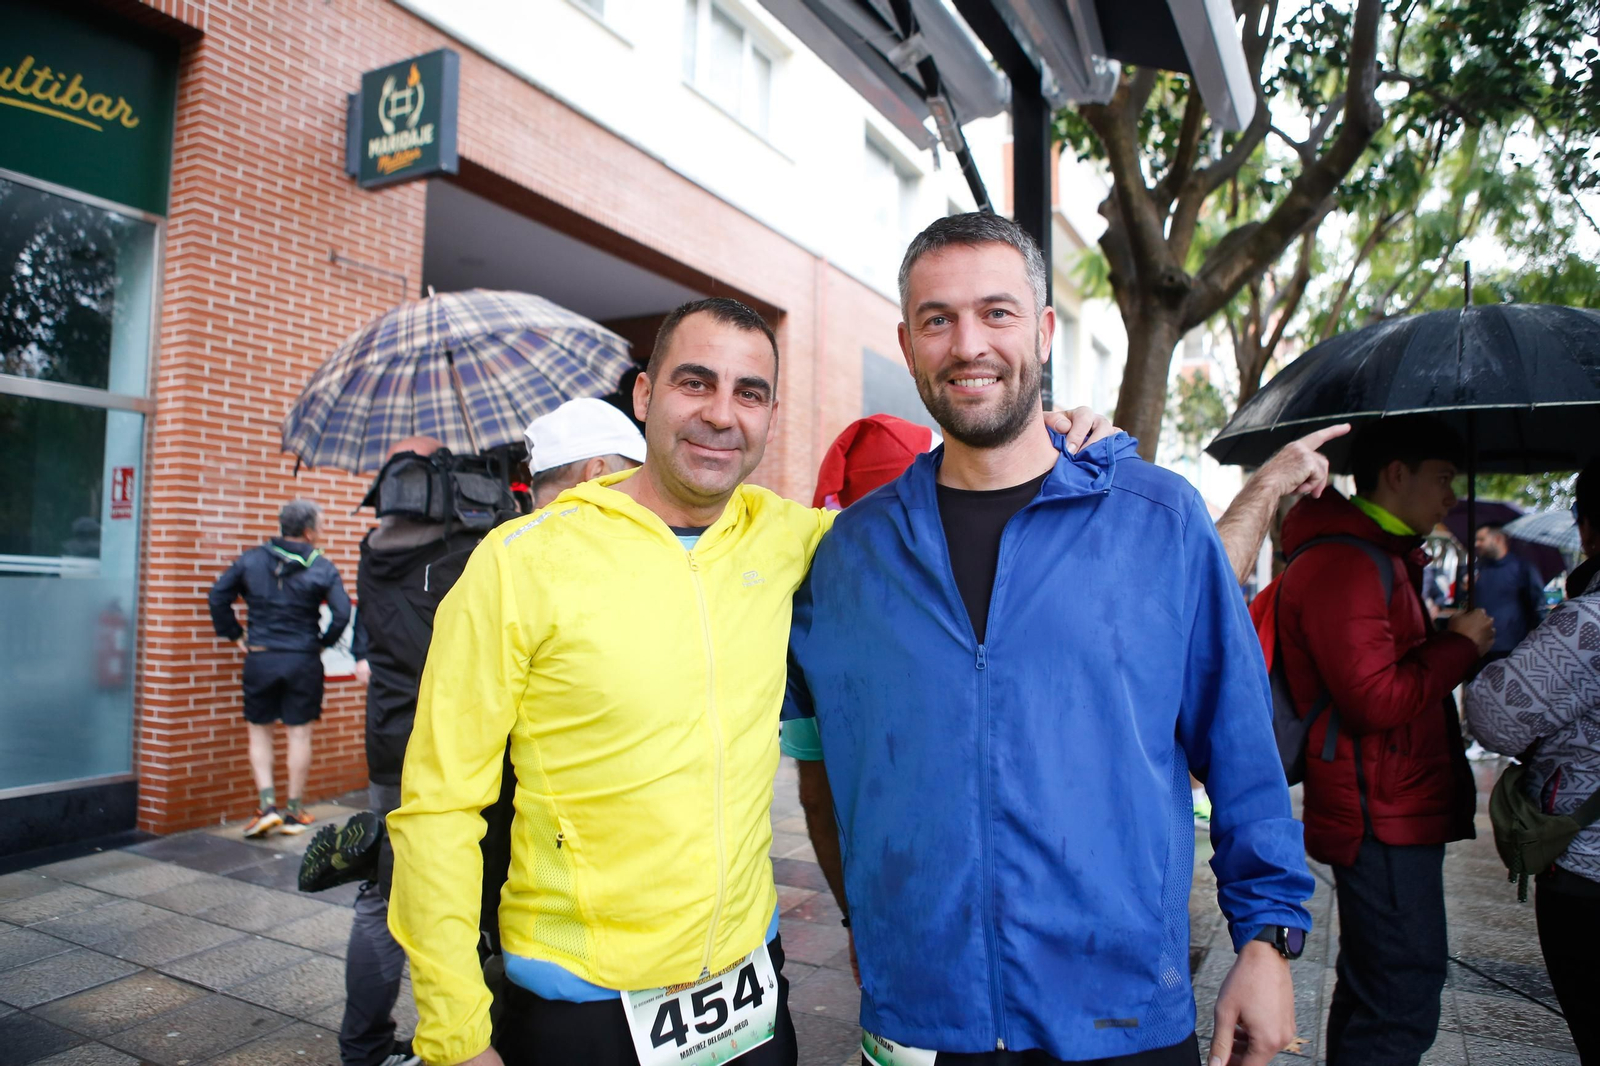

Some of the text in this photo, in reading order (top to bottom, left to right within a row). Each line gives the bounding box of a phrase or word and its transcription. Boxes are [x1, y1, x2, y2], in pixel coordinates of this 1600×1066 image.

[368, 123, 434, 159] MARIDAJE
[650, 962, 765, 1049] 454
[680, 1019, 749, 1060] MARTINEZ DELGADO, DIEGO
